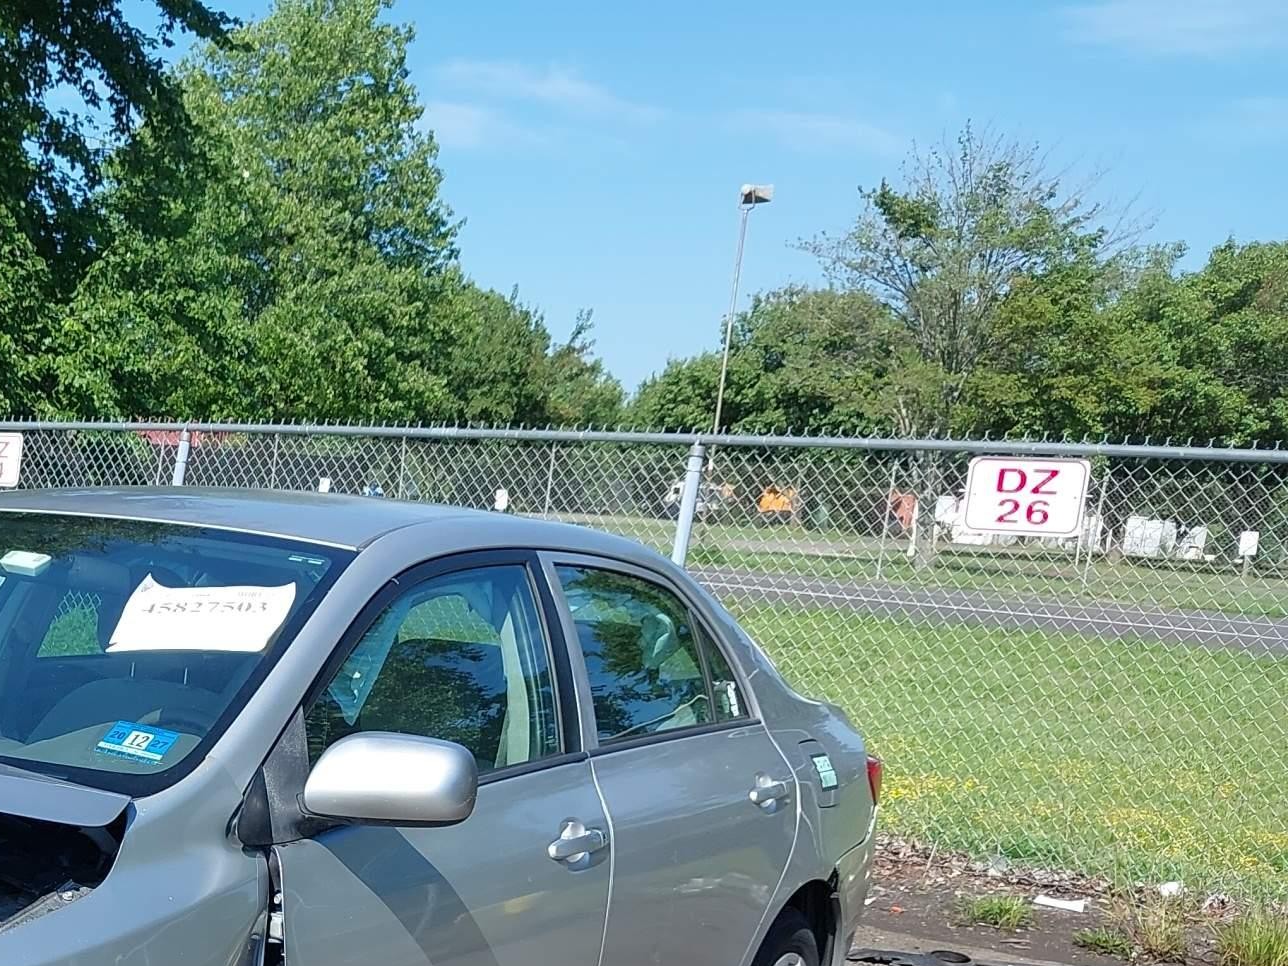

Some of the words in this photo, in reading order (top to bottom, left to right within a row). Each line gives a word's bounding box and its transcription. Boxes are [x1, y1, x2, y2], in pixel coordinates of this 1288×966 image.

[996, 468, 1060, 494] DZ
[995, 498, 1050, 525] 26
[141, 600, 268, 614] 45827503
[128, 734, 150, 748] 12
